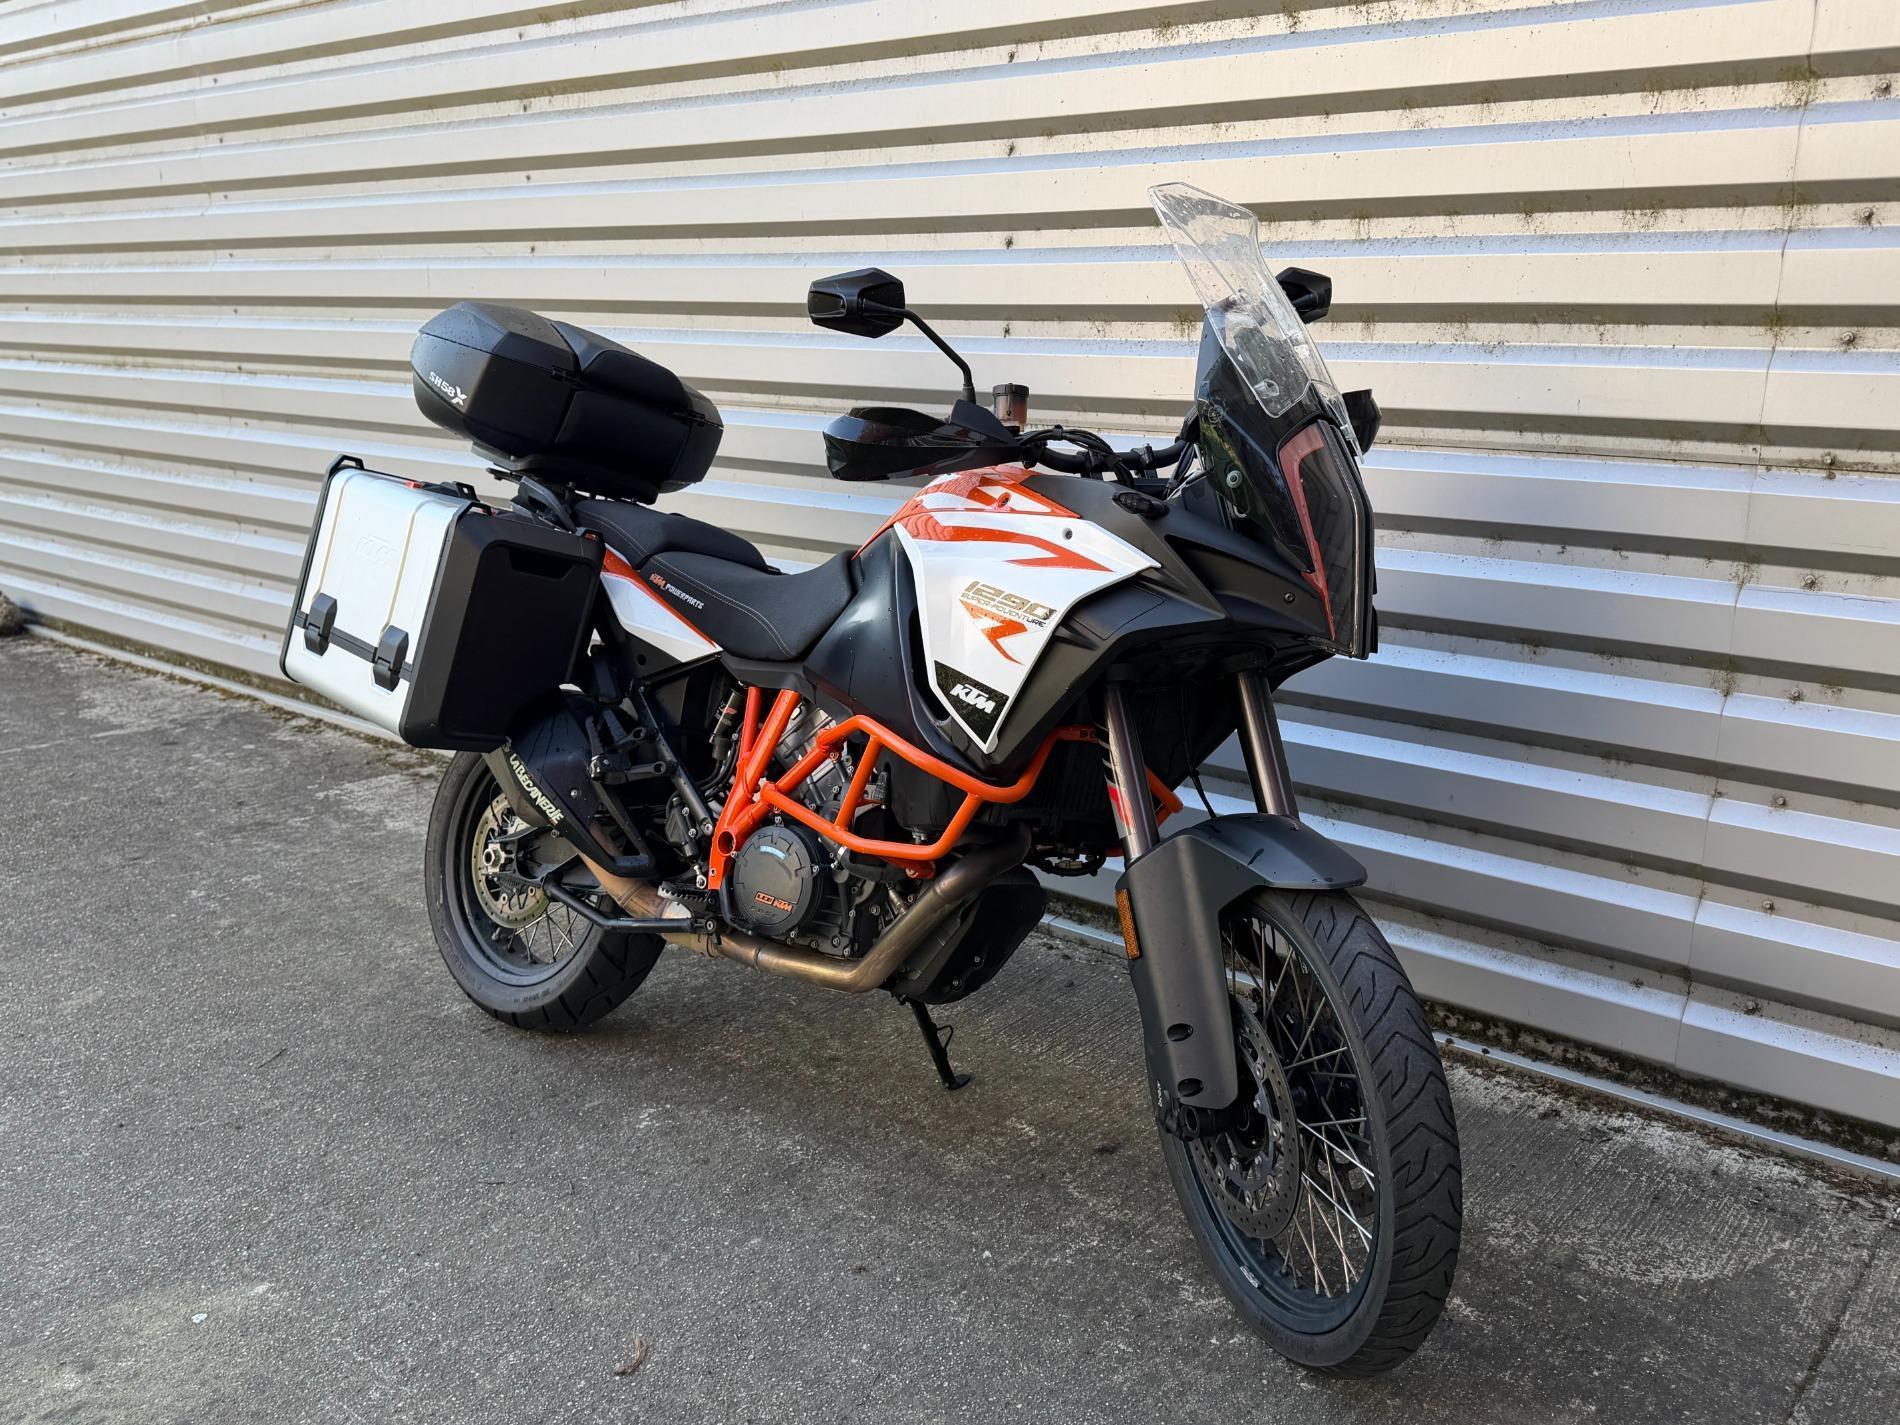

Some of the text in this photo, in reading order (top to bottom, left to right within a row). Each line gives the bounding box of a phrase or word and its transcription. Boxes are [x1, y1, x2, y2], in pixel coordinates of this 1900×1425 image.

[666, 583, 705, 610] POWERPARTS
[965, 580, 1058, 620] 1290
[950, 683, 996, 714] KTM
[773, 899, 793, 912] KTM
